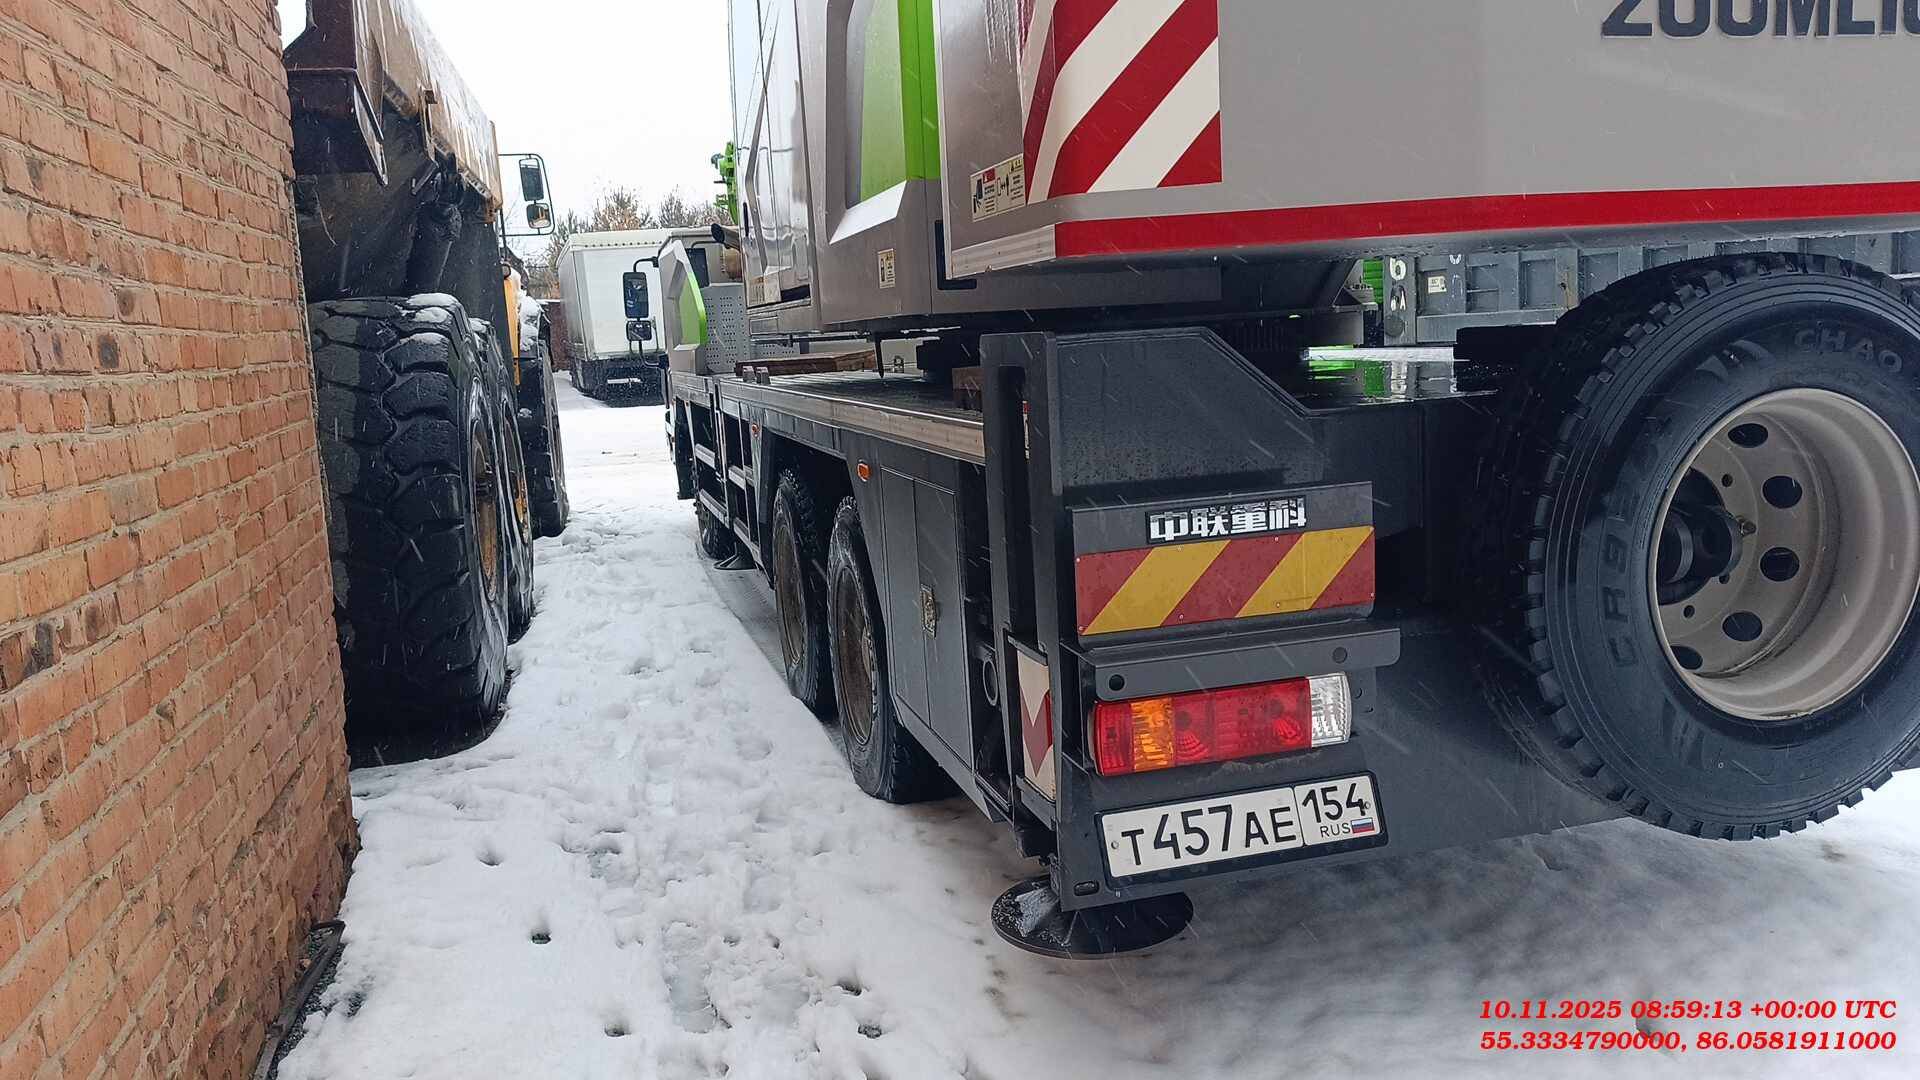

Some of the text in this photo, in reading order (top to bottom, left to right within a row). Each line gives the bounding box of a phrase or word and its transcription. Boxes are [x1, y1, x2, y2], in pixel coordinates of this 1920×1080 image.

[1150, 498, 1307, 541] 中联重科
[1302, 783, 1366, 823] 154
[1319, 822, 1351, 838] RUS
